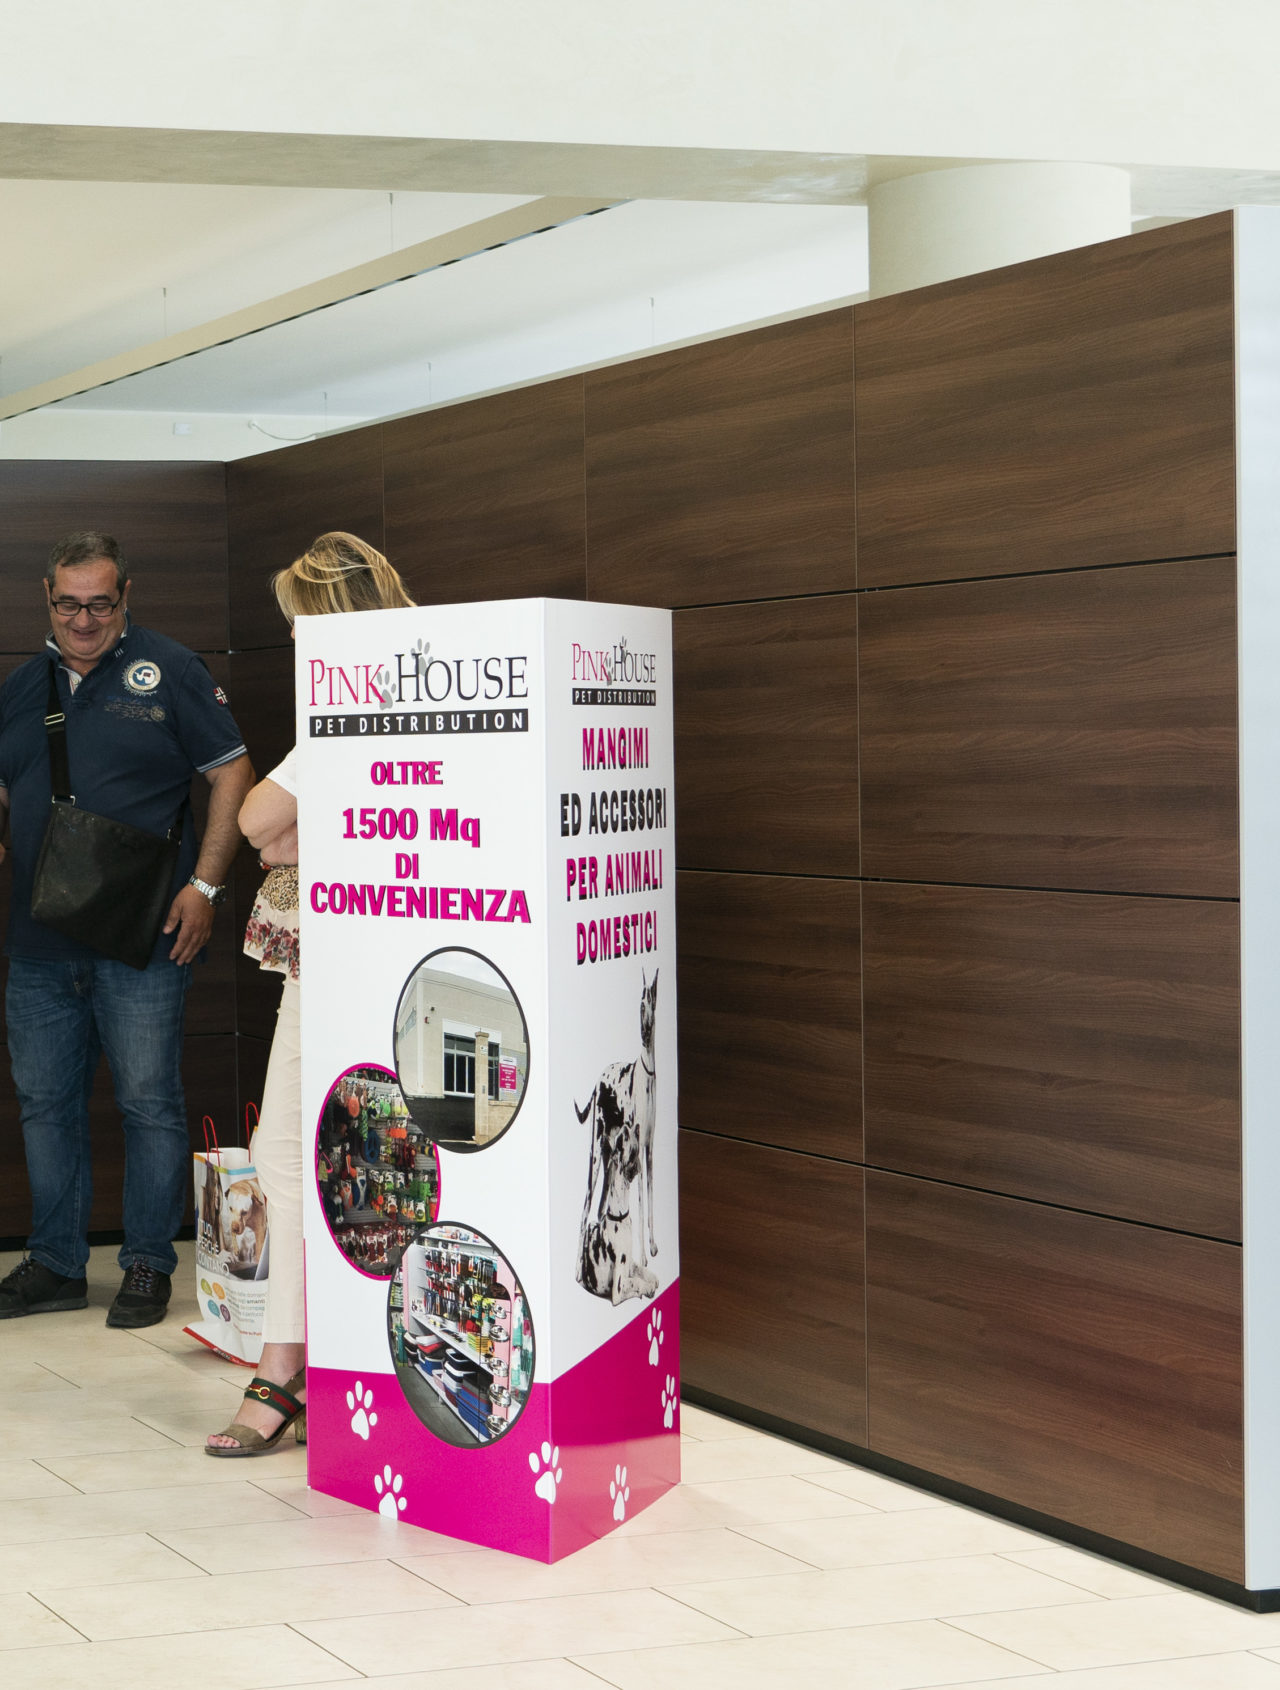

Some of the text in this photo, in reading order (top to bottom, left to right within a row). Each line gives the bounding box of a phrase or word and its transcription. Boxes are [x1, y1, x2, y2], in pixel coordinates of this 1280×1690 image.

[308, 652, 529, 706] PINK HOUSE
[572, 643, 656, 684] PINK HOUSE
[575, 690, 656, 705] PET DISTRIBUTION
[315, 711, 523, 735] PET DISTRIBUTION
[582, 727, 649, 771] MANGIMI
[370, 760, 443, 786] OLTRE
[341, 807, 481, 849] 1500 Mq
[560, 787, 667, 837] ED ACCESSORI
[395, 852, 420, 880] DI
[566, 848, 663, 902] PER ANIMALI
[309, 881, 532, 924] CONVENIENZA
[576, 910, 658, 966] DOMESTICI
